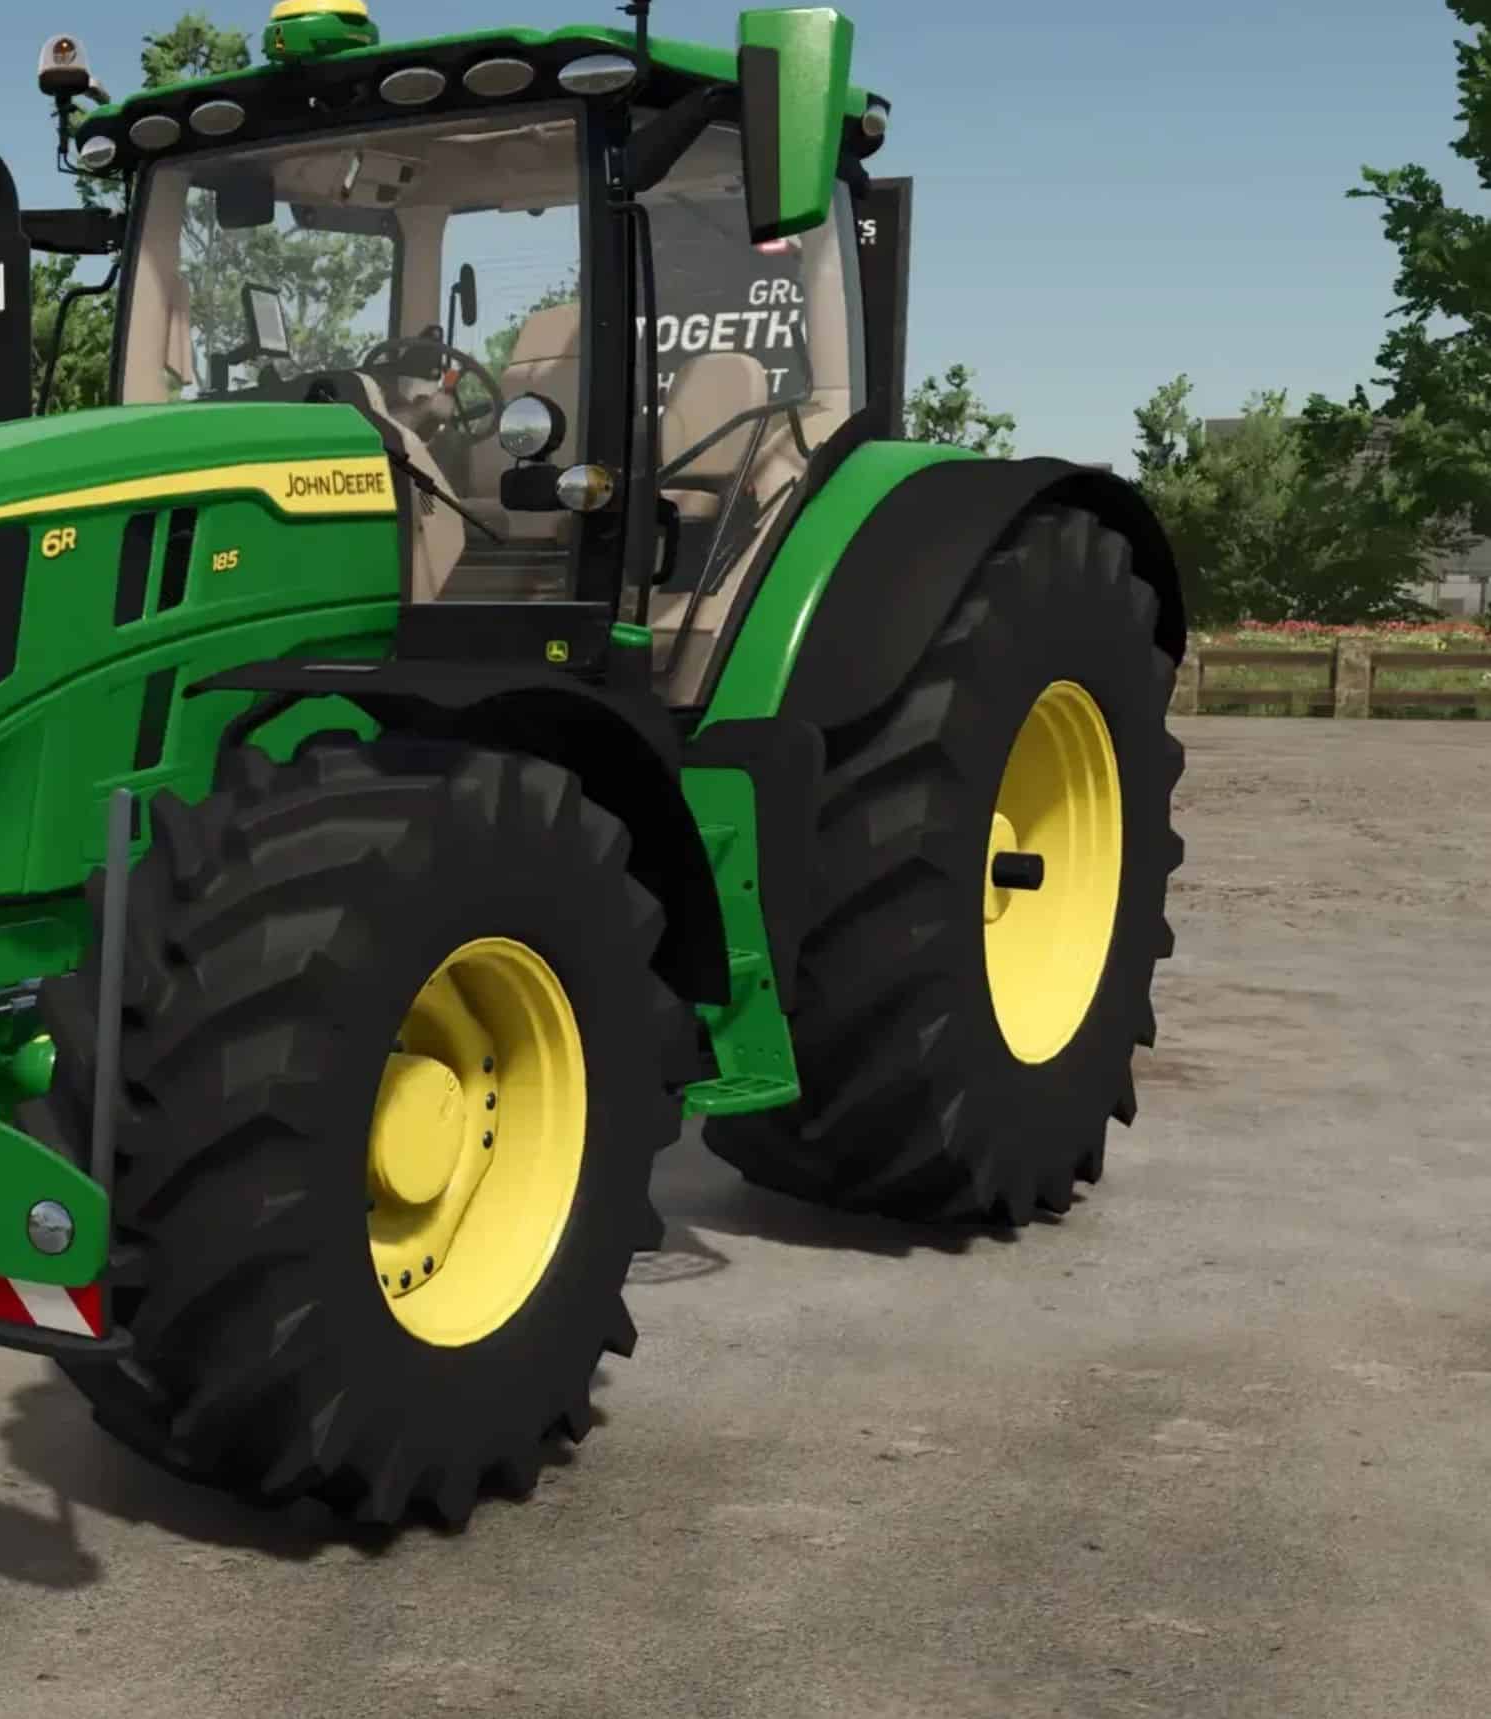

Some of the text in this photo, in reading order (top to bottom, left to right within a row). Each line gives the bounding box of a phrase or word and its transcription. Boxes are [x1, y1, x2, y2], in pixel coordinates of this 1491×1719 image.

[284, 469, 386, 498] JOHN DEERE
[41, 527, 77, 558] 6R
[212, 549, 239, 571] 185
